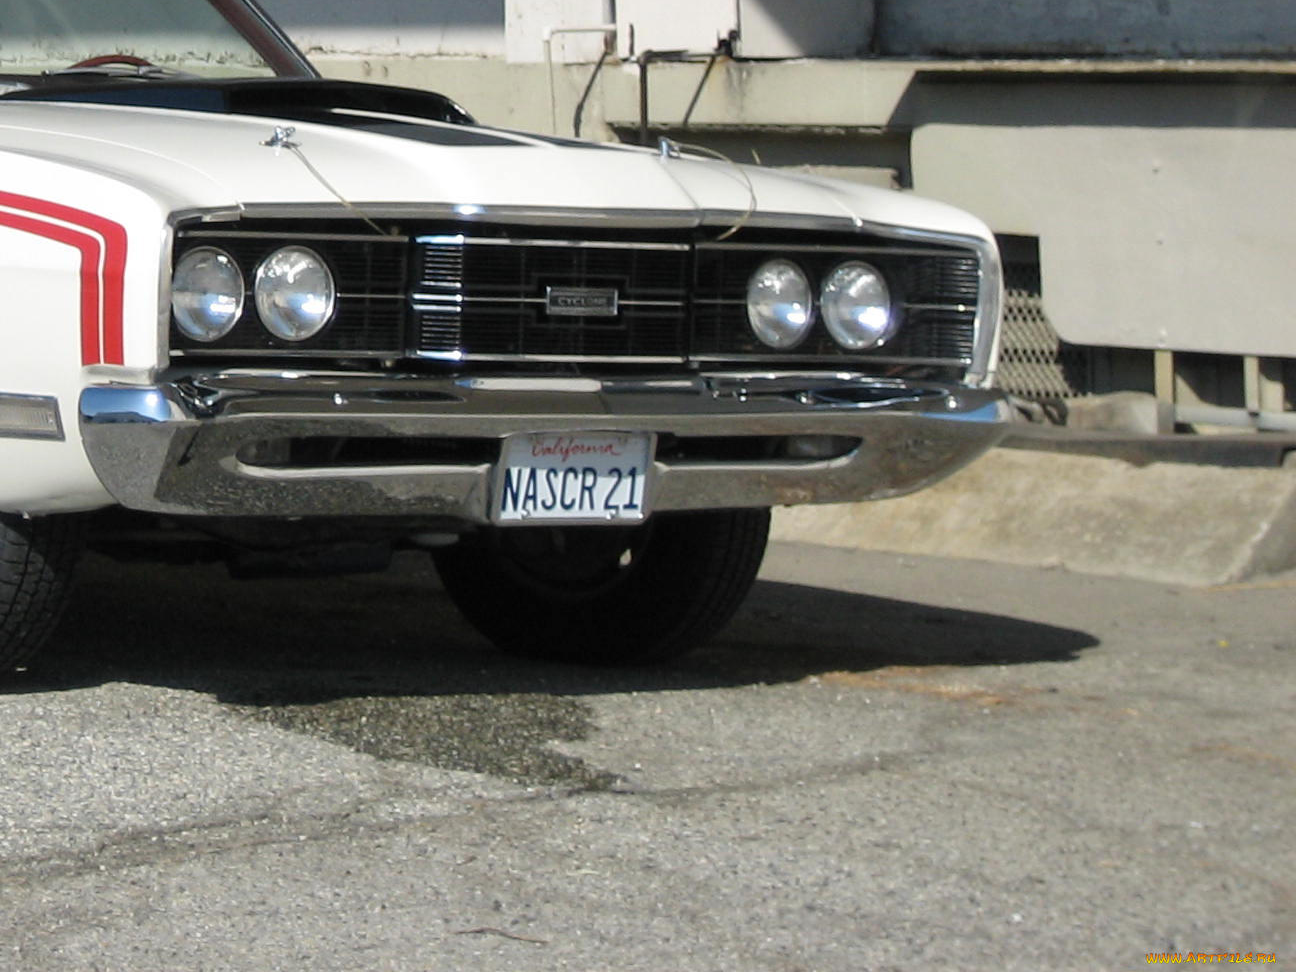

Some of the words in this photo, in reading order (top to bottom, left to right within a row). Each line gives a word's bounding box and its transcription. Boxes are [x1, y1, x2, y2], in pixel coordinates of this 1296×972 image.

[531, 435, 622, 463] California
[501, 466, 598, 512] NASCR
[604, 466, 639, 511] 21
